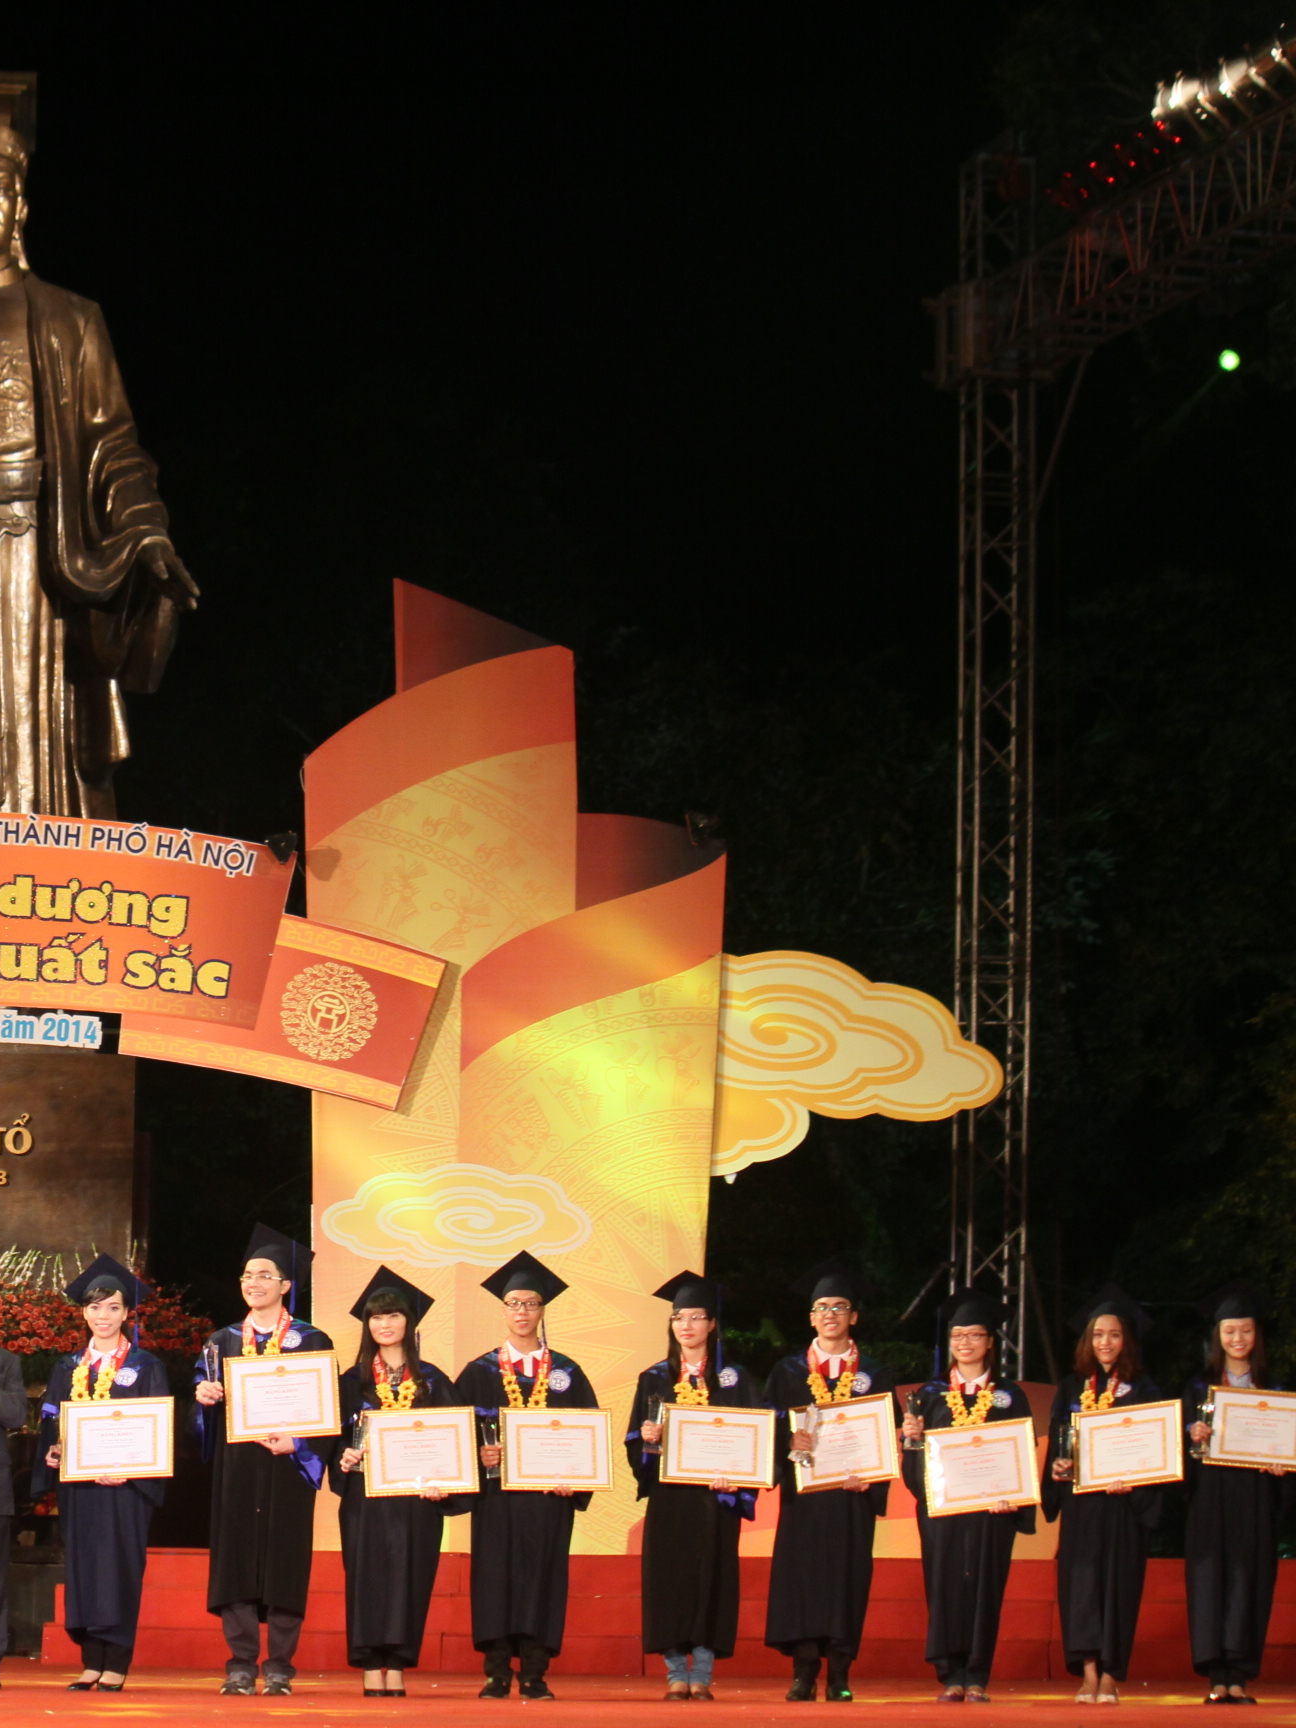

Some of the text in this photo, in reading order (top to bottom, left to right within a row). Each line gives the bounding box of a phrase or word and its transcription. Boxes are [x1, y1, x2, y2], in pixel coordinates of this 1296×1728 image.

[90, 822, 148, 854] PHỐ
[156, 829, 193, 861] HÀ
[203, 841, 256, 877] NỘI
[122, 944, 233, 999] sắc
[42, 1017, 98, 1045] 2014
